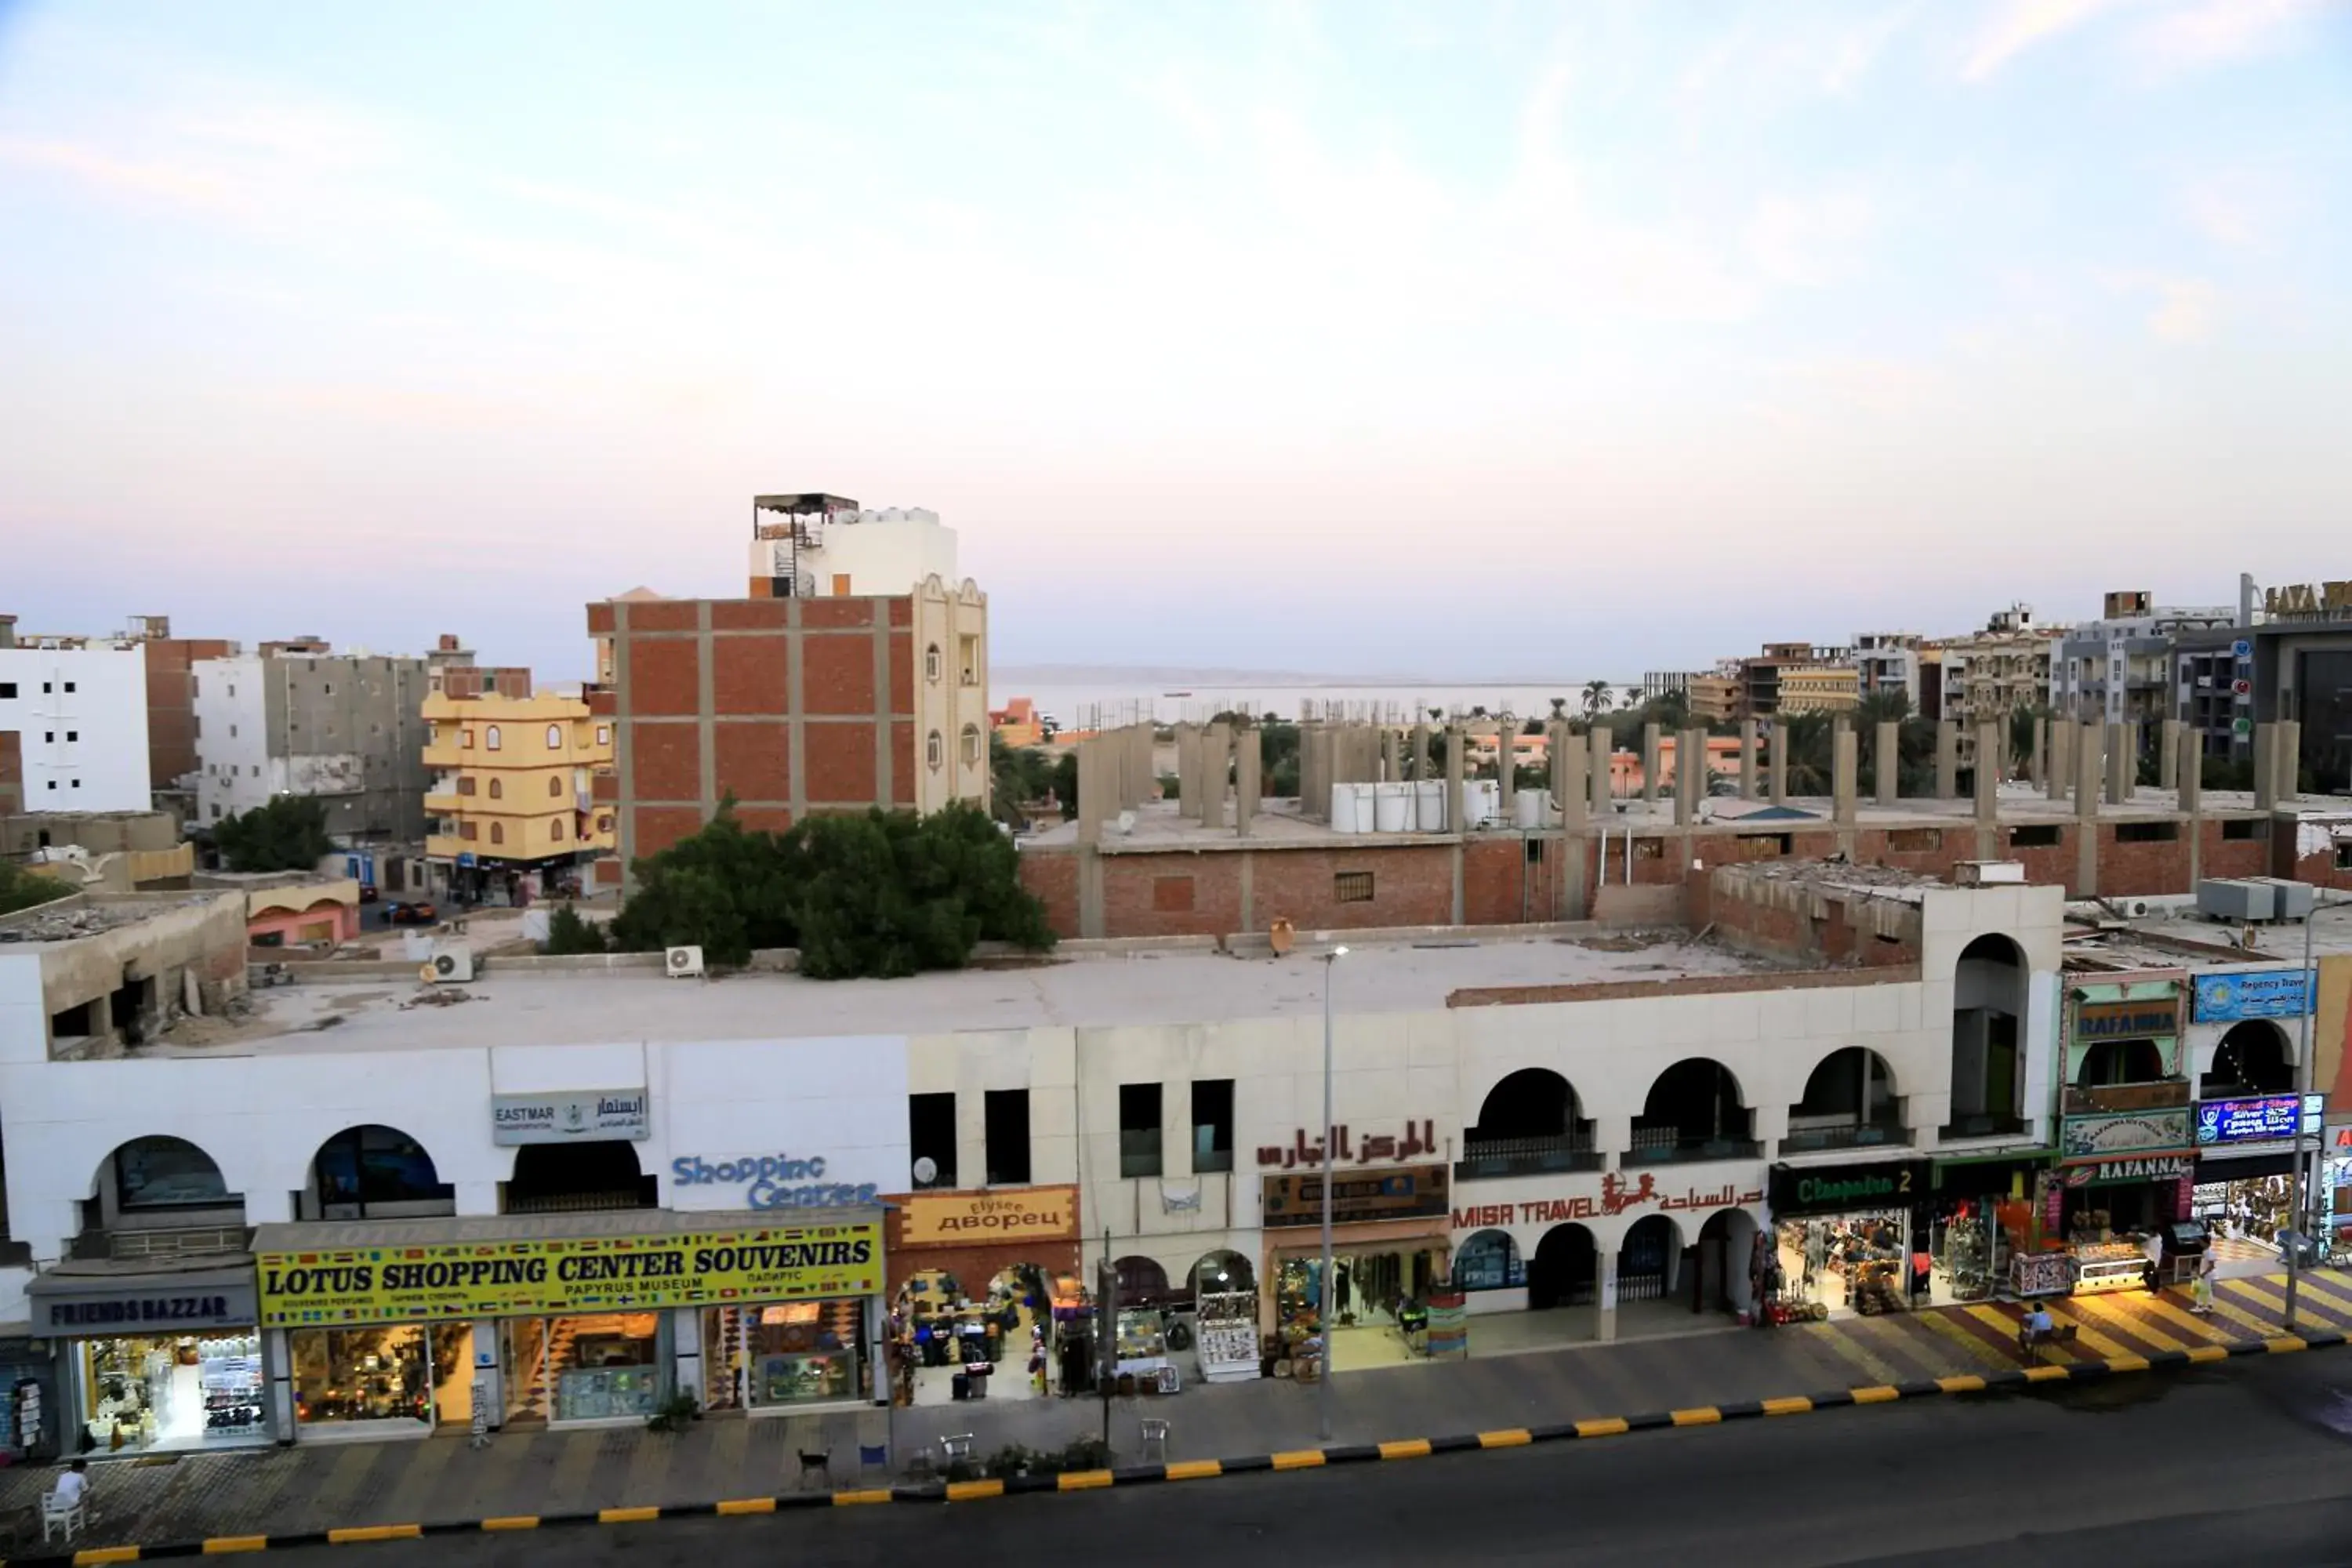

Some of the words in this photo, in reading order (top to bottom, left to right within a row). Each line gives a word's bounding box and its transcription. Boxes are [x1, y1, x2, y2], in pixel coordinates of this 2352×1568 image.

[2282, 978, 2306, 988] Trave
[495, 1107, 554, 1121] EASTMAR
[2224, 1101, 2263, 1111] Grand
[1356, 1119, 1437, 1164] المركز
[2100, 1156, 2182, 1180] RAFANNA
[1899, 1170, 1912, 1192] 2
[970, 1200, 1024, 1214] Elysee
[1659, 1185, 1734, 1212] للسياحة
[1452, 1204, 1514, 1229] MISR
[1519, 1197, 1599, 1224] TRAVEL
[266, 1265, 373, 1295] LOTUS
[382, 1256, 548, 1290] SHOPPING
[557, 1250, 685, 1282] CENTER
[693, 1240, 871, 1274] SOUVENIRS
[747, 1271, 804, 1283] ПАПИРУС
[564, 1282, 633, 1294] PAPYRUS
[639, 1278, 703, 1292] MUSEUM
[51, 1300, 140, 1327] FRIENDS
[143, 1296, 228, 1320] BAZZAR
